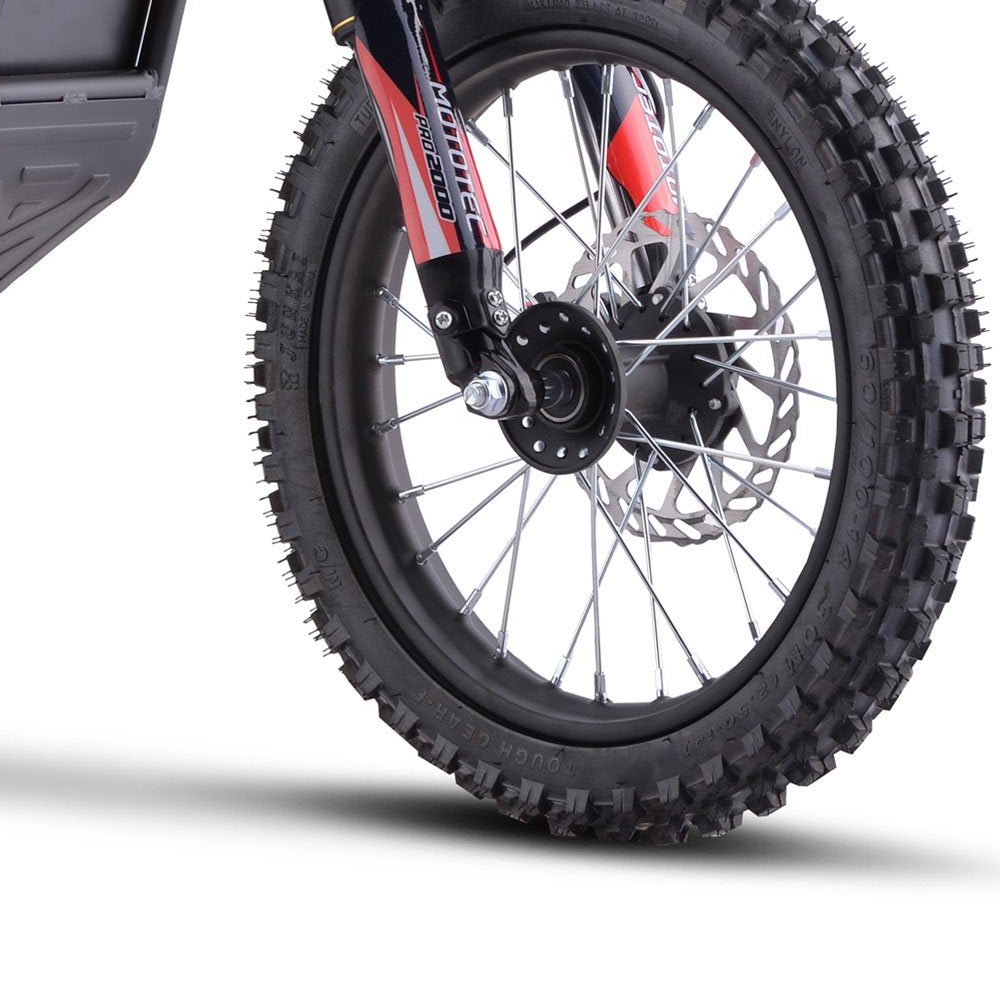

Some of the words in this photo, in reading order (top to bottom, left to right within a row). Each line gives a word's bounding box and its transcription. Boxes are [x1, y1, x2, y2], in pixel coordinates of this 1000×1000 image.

[431, 80, 489, 238] MOTOTEC
[771, 117, 808, 169] NYLON
[500, 742, 577, 778] TOUGH
